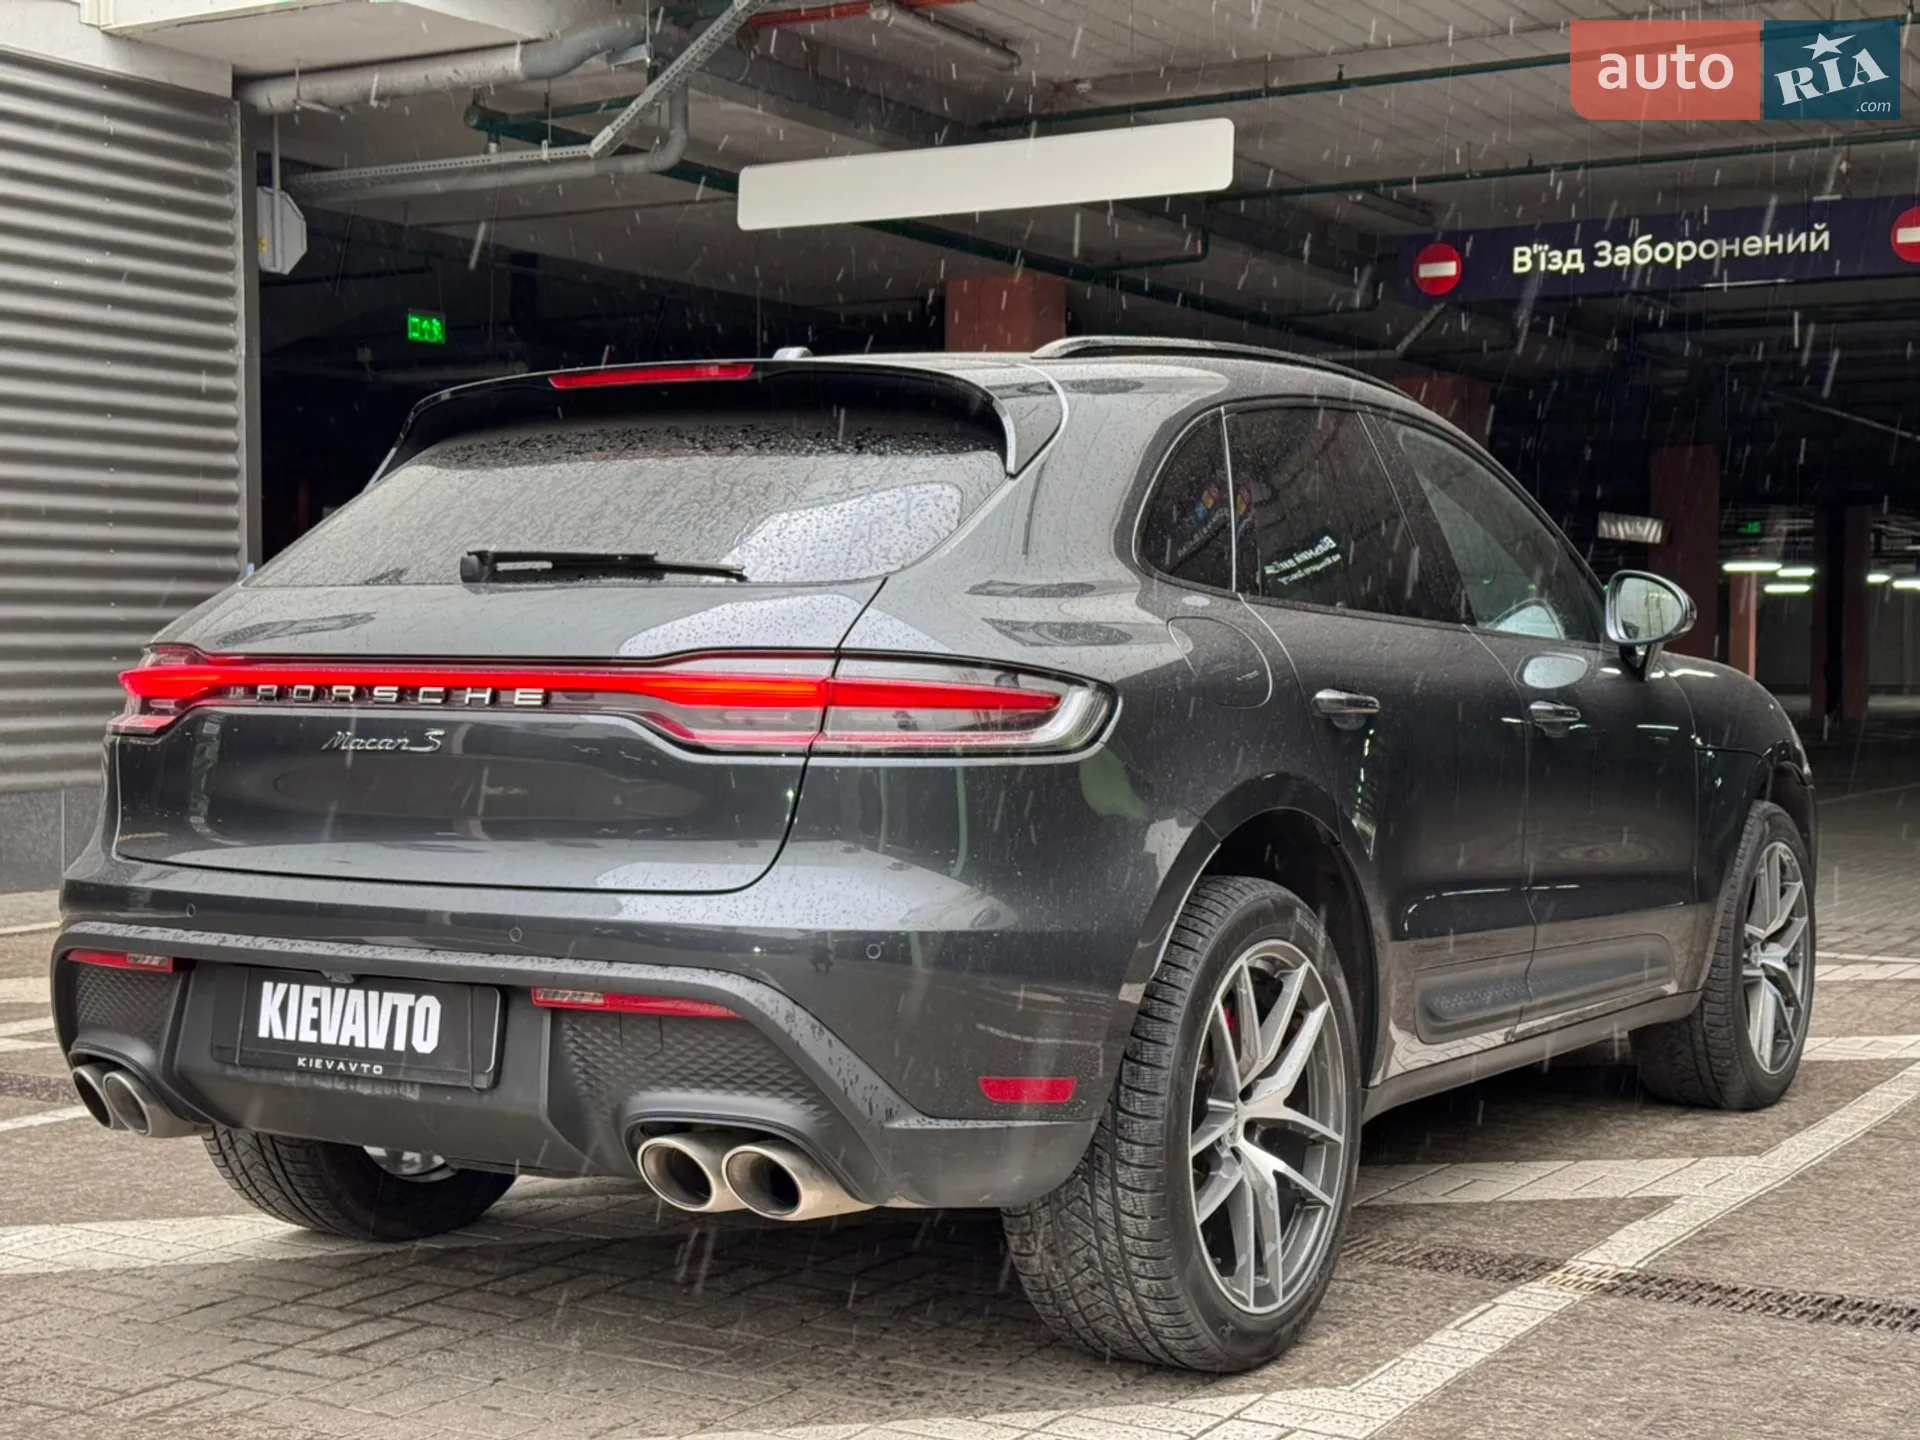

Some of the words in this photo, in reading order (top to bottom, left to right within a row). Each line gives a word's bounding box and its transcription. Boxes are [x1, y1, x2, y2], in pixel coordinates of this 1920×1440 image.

[1594, 224, 1831, 269] Заборонений
[256, 685, 545, 707] PORSCHE
[320, 731, 410, 751] Macan
[258, 981, 442, 1055] KIEVAVTO
[297, 1056, 383, 1075] KIEVAVTO
